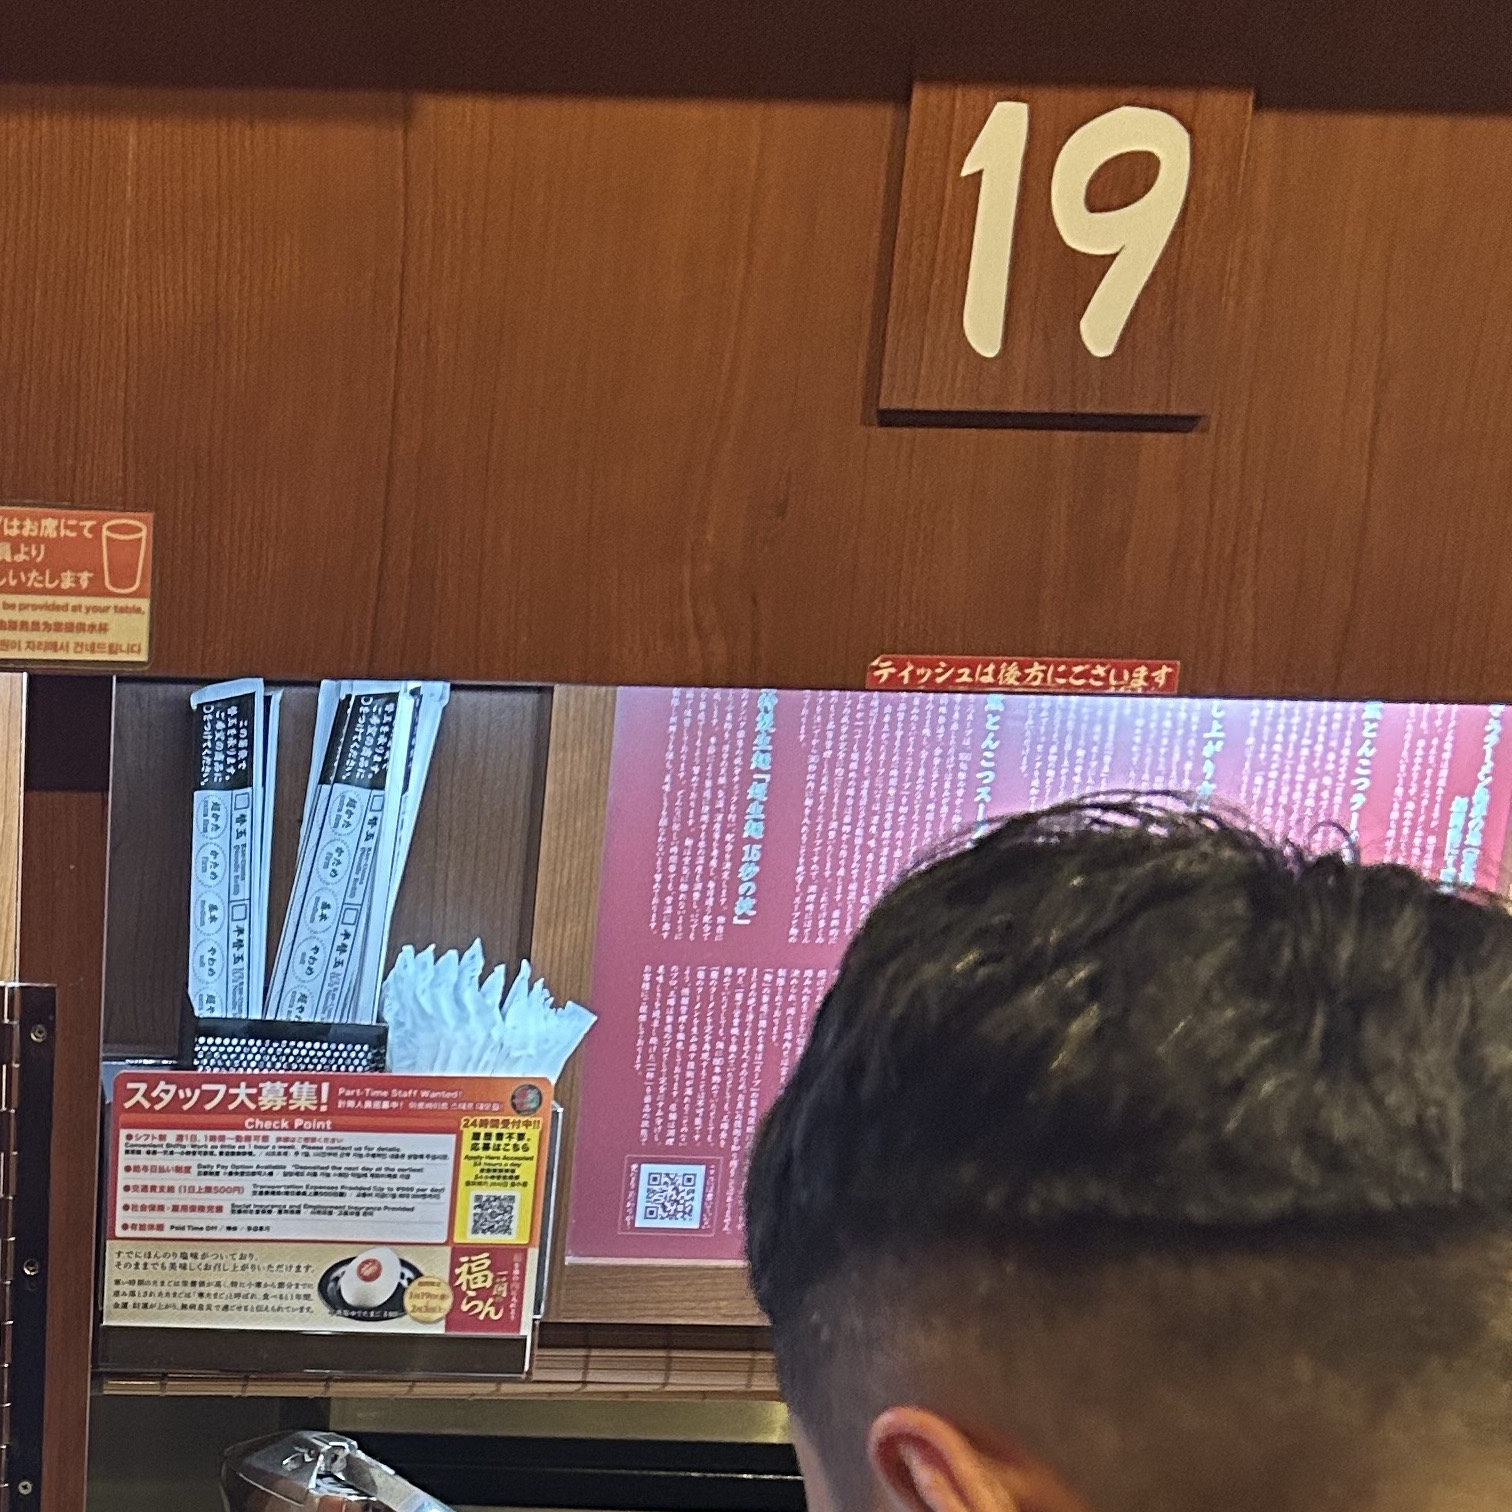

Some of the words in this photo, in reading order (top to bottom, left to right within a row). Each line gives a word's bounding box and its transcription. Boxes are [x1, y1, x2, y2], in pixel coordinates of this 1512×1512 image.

[961, 100, 1191, 359] 19
[2, 600, 17, 610] be
[18, 601, 68, 614] provided
[71, 602, 82, 613] at
[85, 604, 111, 616] your
[872, 658, 1173, 689] ティッシュは後方にございます
[209, 850, 220, 881] かため
[329, 846, 345, 878] かため
[207, 946, 217, 977] やわめ
[305, 945, 320, 976] やわめ
[123, 1081, 331, 1112] スタッフ大募集!
[337, 1086, 388, 1098] Part-Time
[390, 1087, 418, 1098] Staff
[244, 1117, 290, 1130] Check
[293, 1118, 333, 1130] Point
[462, 1118, 541, 1130] 24時間受付中!!
[470, 1142, 530, 1152] 応募はこちら
[454, 1252, 505, 1321] 福らん
